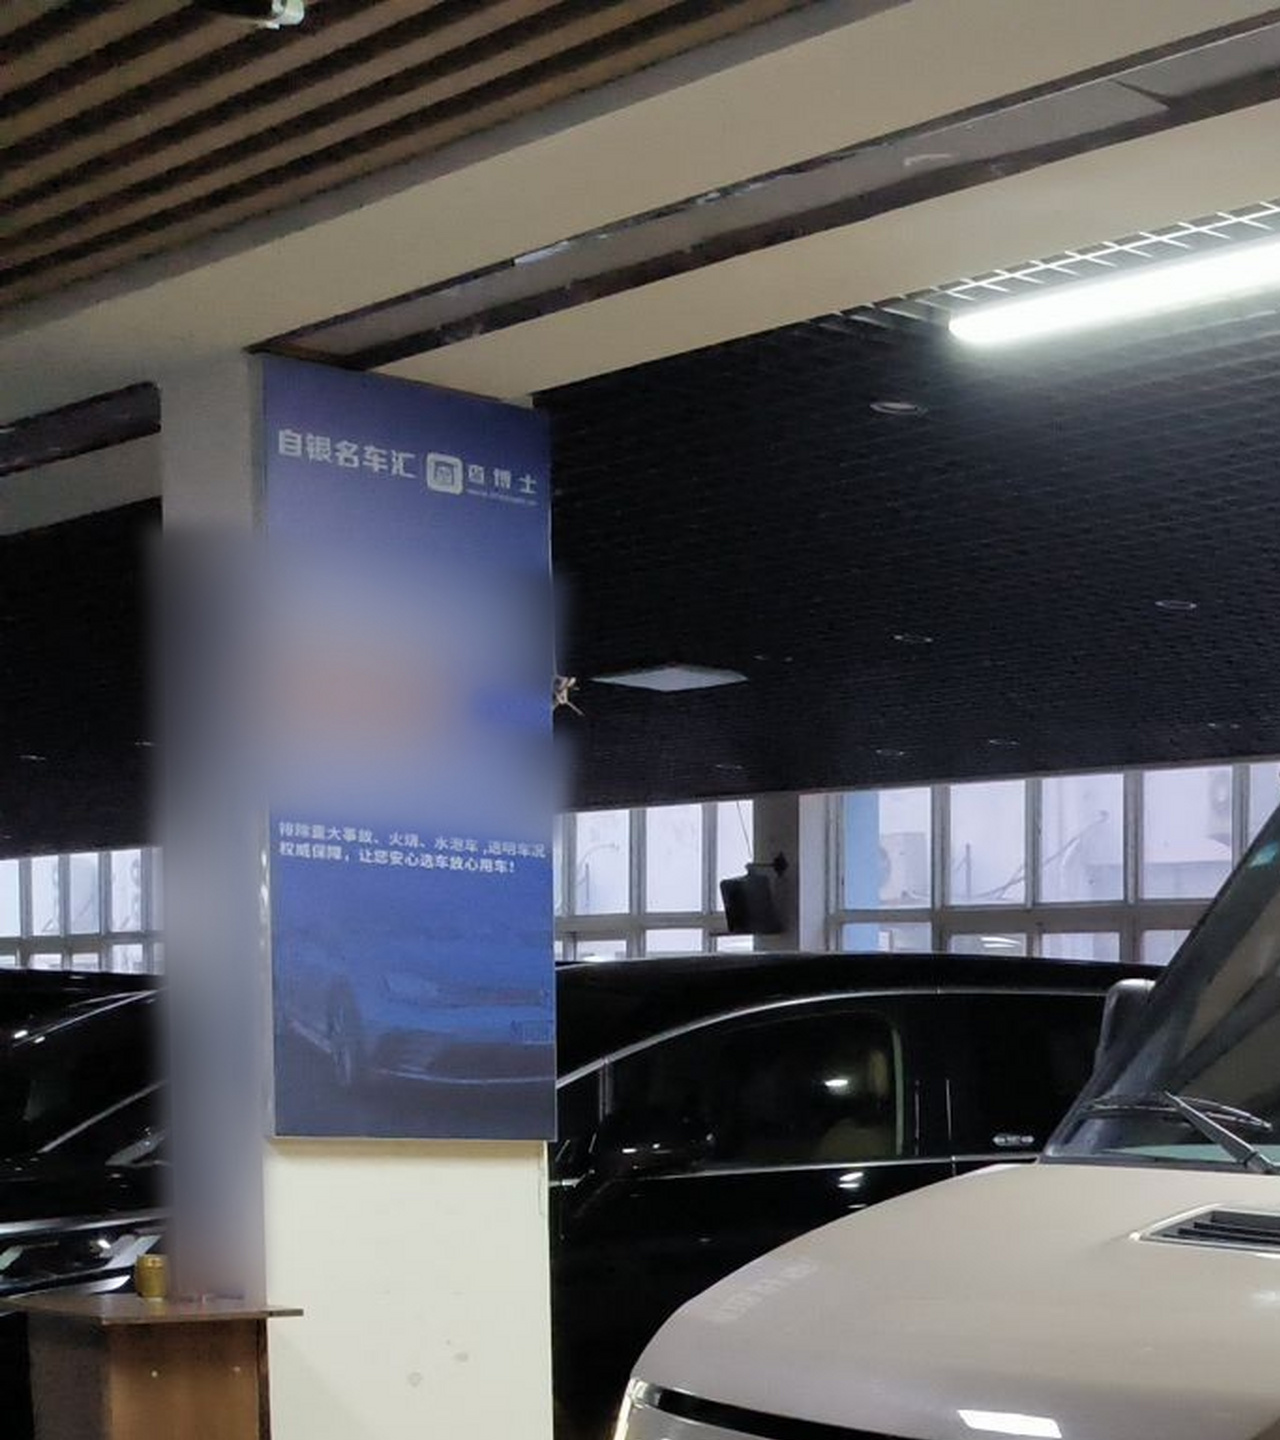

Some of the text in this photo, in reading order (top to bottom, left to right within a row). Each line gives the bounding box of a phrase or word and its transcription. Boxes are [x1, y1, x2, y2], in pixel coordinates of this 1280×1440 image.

[278, 428, 417, 479] 自银名车汇
